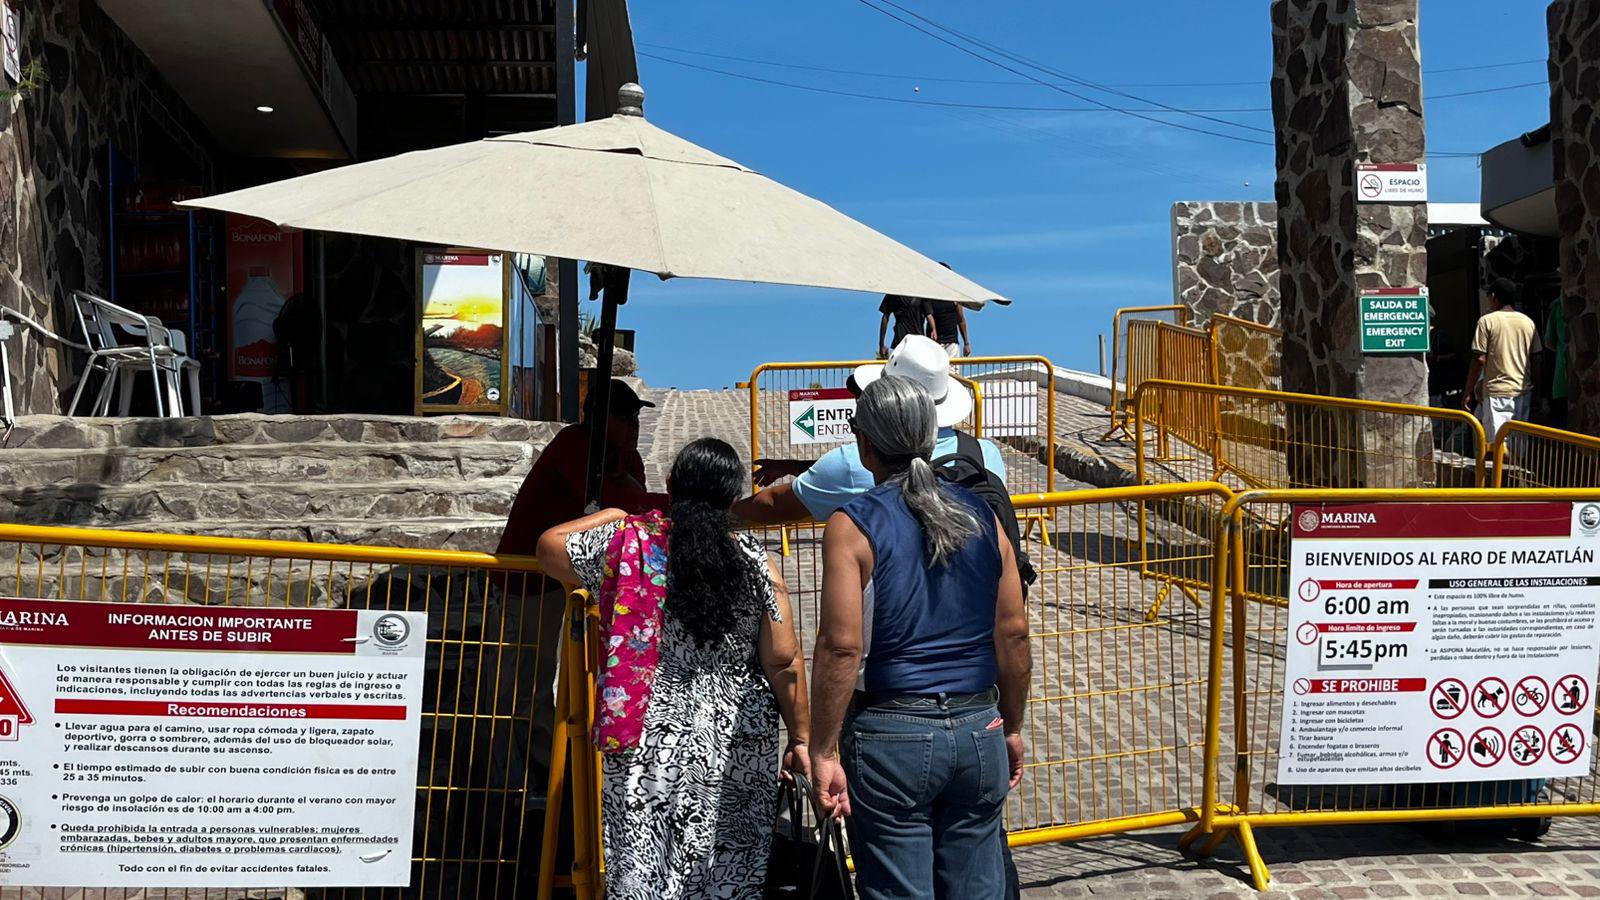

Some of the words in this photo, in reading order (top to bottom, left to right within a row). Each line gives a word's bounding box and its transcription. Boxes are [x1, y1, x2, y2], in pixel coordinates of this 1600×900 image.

[1370, 301, 1403, 309] SALIDA
[1364, 312, 1424, 320] EMERGENCIA
[1366, 328, 1424, 336] EMERGENCY
[1385, 339, 1405, 347] EXIT
[817, 409, 854, 420] ENTR
[818, 424, 850, 435] ENTR
[1321, 512, 1377, 524] MARINA
[1305, 551, 1414, 566] BIENVENIDOS
[1418, 550, 1438, 564] AL
[1442, 550, 1483, 564] FARO
[1487, 550, 1507, 564] DE
[1511, 547, 1594, 563] MAZATLÁN
[1363, 581, 1393, 589] apertura
[1449, 579, 1466, 588] USO
[1467, 579, 1502, 587] GENERAL
[1503, 578, 1514, 587] DE
[1515, 578, 1530, 587] LAS
[1530, 577, 1588, 586] INSTALACIONES
[1325, 596, 1371, 614] 6:00
[1377, 599, 1409, 614] am
[0, 611, 69, 626] ARINA
[108, 613, 214, 627] INFORMACION
[218, 616, 312, 629] IMPORTANTE
[1328, 624, 1345, 632] Hora
[1376, 624, 1401, 632] ingreso
[148, 629, 199, 641] ANTES
[203, 630, 223, 641] DE
[227, 631, 272, 643] SUBIR
[57, 664, 77, 672] Los
[79, 664, 132, 673] visitantes
[134, 665, 167, 674] tienen
[170, 666, 179, 674] la
[182, 666, 237, 678] obligación
[239, 668, 252, 676] de
[254, 668, 291, 679] ejercer
[309, 669, 335, 678] buen
[367, 672, 374, 681] y
[376, 671, 408, 679] actuar
[56, 674, 70, 682] de
[115, 675, 180, 687] responsable
[183, 678, 189, 687] y
[192, 677, 232, 688] cumplir
[256, 678, 285, 687] todas
[287, 679, 303, 687] las
[305, 679, 337, 690] reglas
[339, 680, 352, 688] de
[354, 680, 393, 691] ingreso
[1321, 680, 1338, 692] SE
[56, 684, 127, 695] indicaciones,
[130, 686, 188, 697] incluyendo
[190, 687, 220, 696] todas
[222, 688, 238, 696] las
[240, 688, 307, 697] advertencias
[309, 689, 352, 698] verbales
[355, 692, 361, 701] y
[363, 690, 406, 699] escritas.
[1300, 700, 1325, 708] Ingresar
[168, 704, 307, 717] Recomendaciones
[65, 722, 98, 731] Llevar
[99, 725, 126, 733] agua
[128, 725, 151, 734] para
[153, 724, 163, 732] el
[165, 724, 205, 734] camino,
[233, 727, 256, 735] ropa
[258, 725, 298, 734] cómoda
[300, 728, 307, 736] y
[342, 727, 375, 737] zapato
[64, 733, 117, 744] deportivo,
[119, 735, 147, 744] gorra
[159, 734, 211, 744] sombrero,
[255, 735, 271, 743] del
[294, 736, 307, 744] de
[309, 736, 365, 747] bloqueador
[367, 737, 394, 746] solar,
[64, 744, 71, 752] y
[73, 742, 112, 751] realizar
[114, 743, 169, 752] descansos
[171, 744, 211, 752] durante
[62, 773, 76, 781] 25
[87, 773, 100, 781] 35
[102, 774, 146, 782] minutos.
[62, 804, 94, 814] riesgo
[96, 804, 110, 812] de
[198, 805, 224, 813] 10:00
[253, 805, 274, 813] 4:00
[276, 807, 295, 816] pm.
[118, 864, 144, 872] Todo
[168, 864, 177, 872] el
[179, 864, 193, 872] fin
[195, 864, 208, 872] de
[210, 864, 239, 872] evitar
[240, 864, 294, 872] accidentes
[296, 864, 331, 872] fatales.
